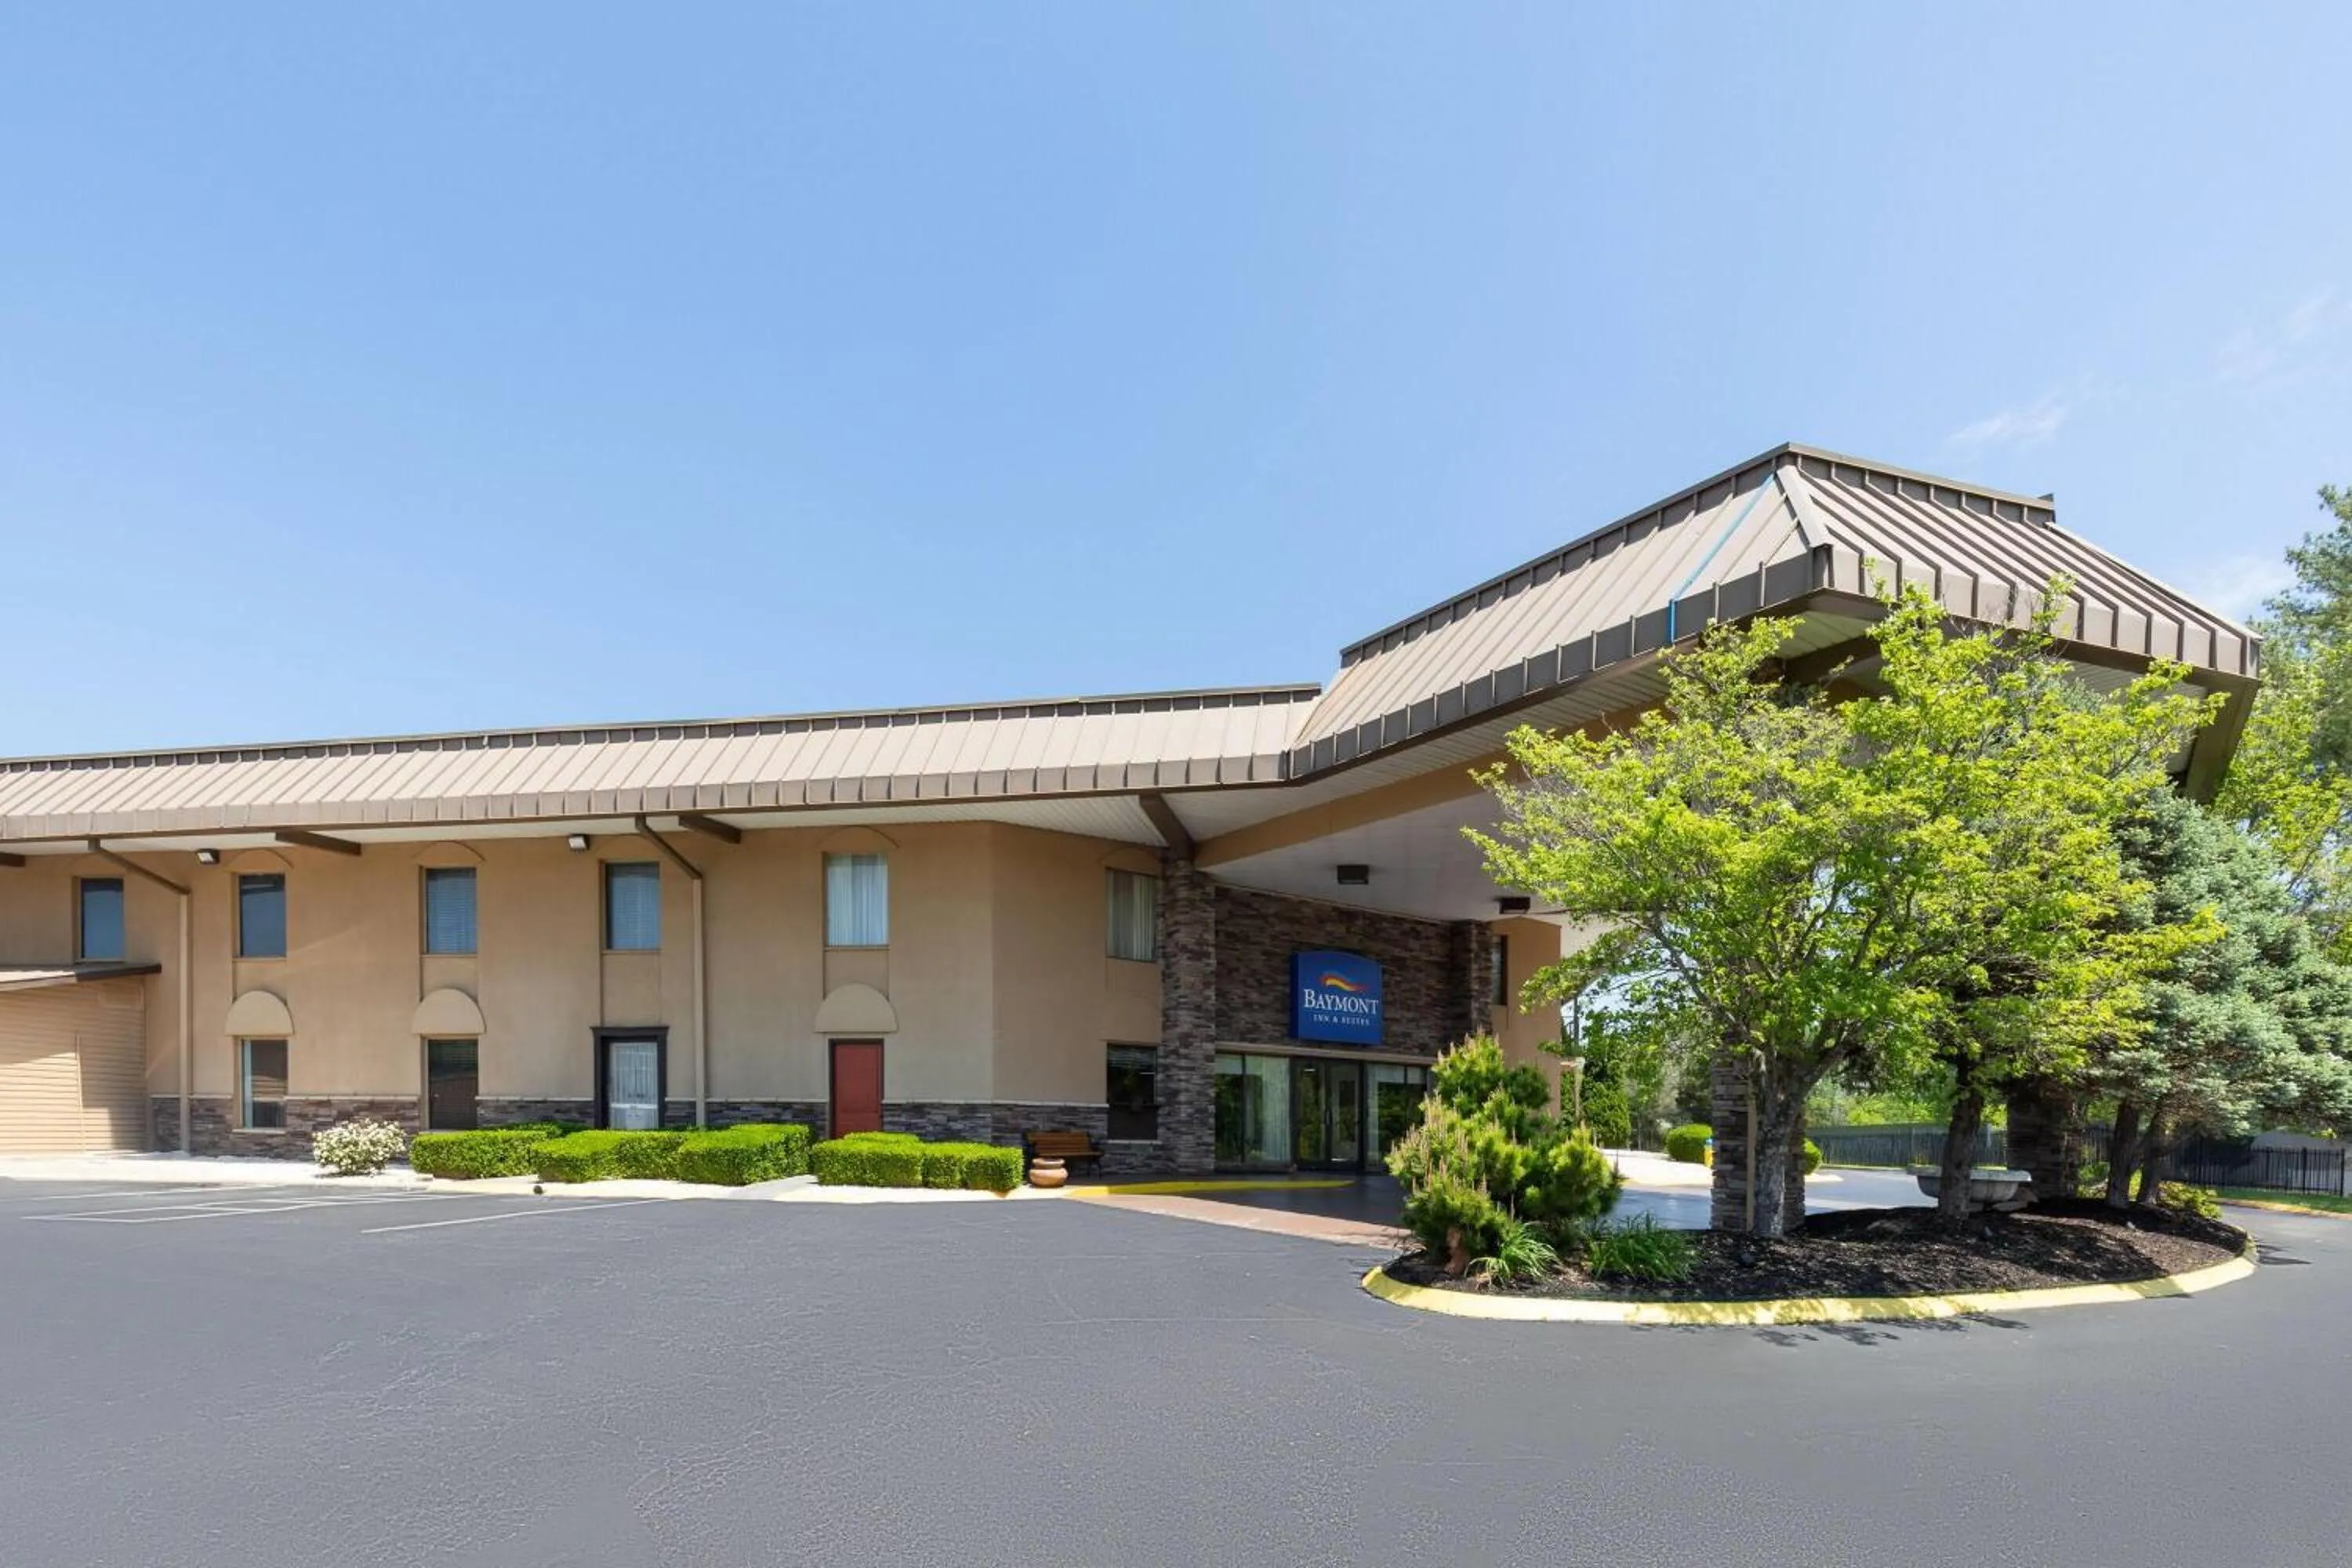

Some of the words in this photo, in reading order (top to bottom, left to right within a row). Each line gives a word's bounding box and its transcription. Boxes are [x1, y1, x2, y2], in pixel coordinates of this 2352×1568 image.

[1304, 989, 1379, 1014] BAYMONT
[1313, 1014, 1329, 1022] INN
[1341, 1017, 1370, 1025] SUITES
